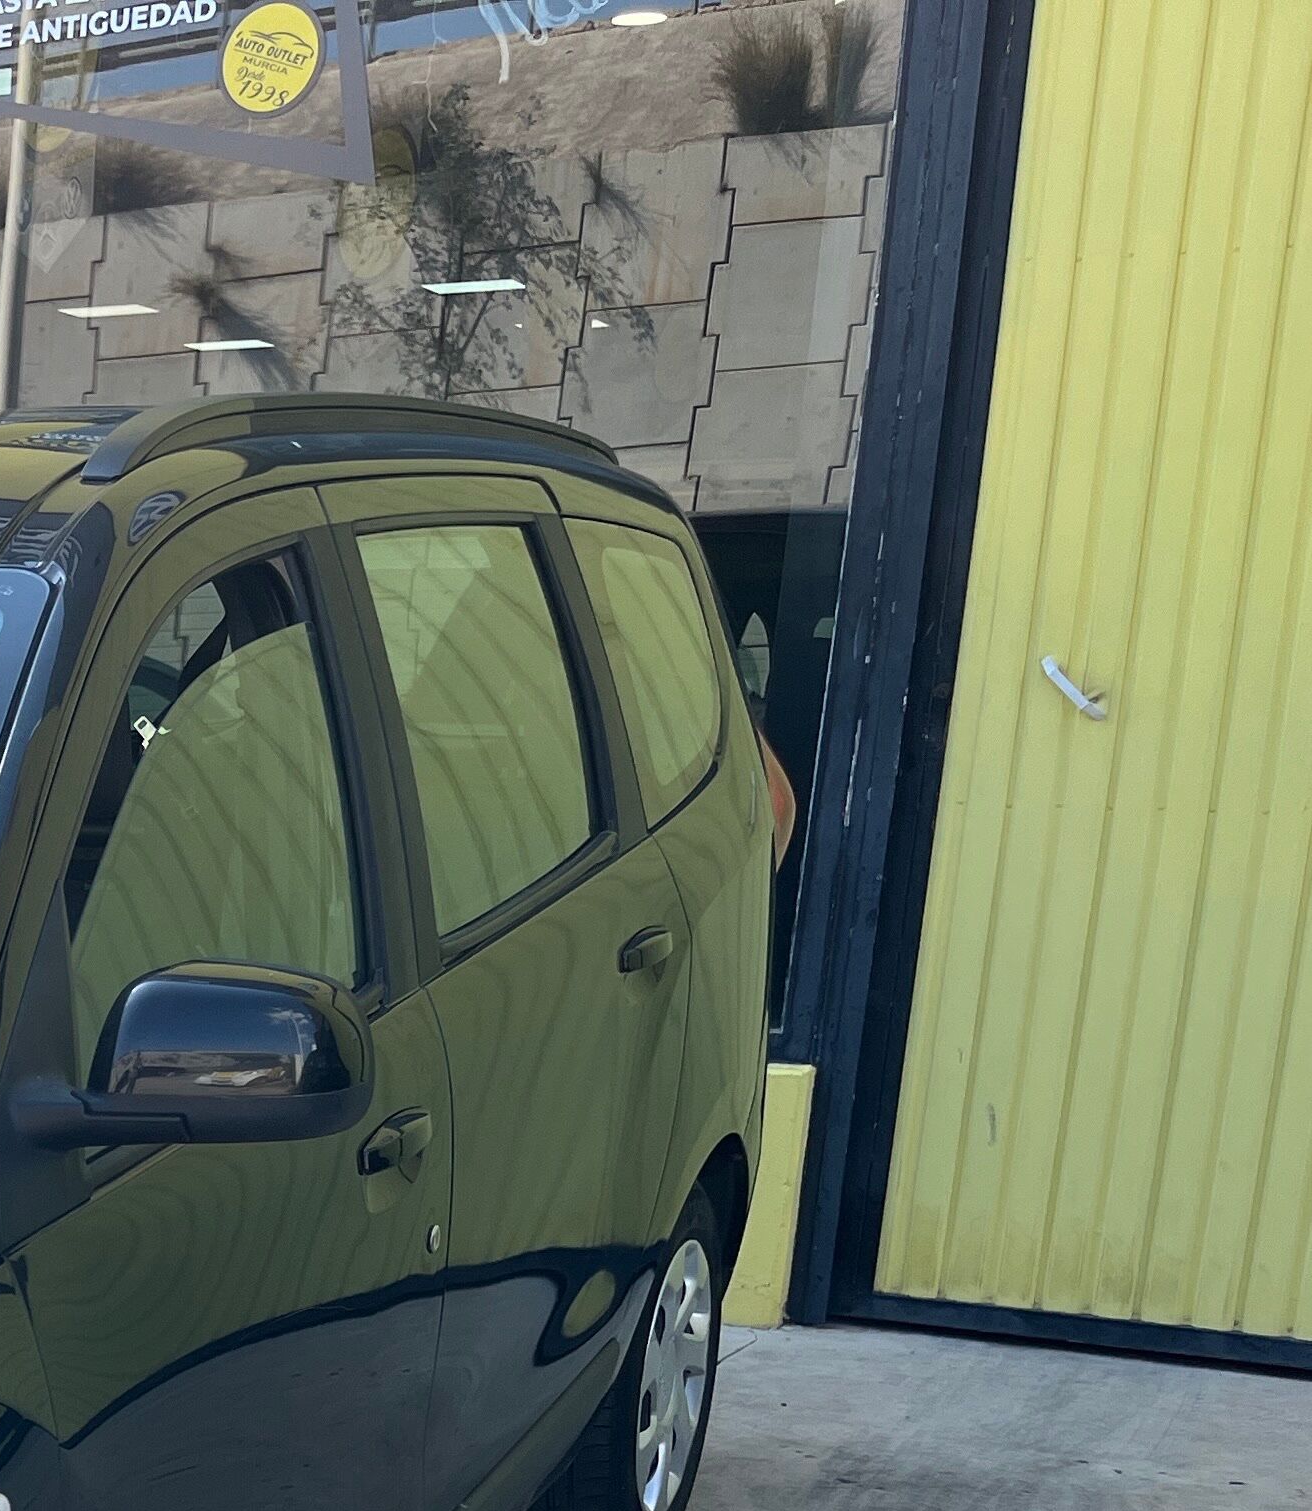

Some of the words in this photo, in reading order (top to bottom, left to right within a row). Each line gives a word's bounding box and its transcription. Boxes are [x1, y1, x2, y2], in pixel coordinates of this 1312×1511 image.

[19, 0, 217, 45] ANTIGUEDAD
[234, 37, 265, 54] AUTO
[266, 45, 309, 66] OUTLET
[242, 55, 289, 76] MURCIA
[238, 79, 290, 107] 1998
